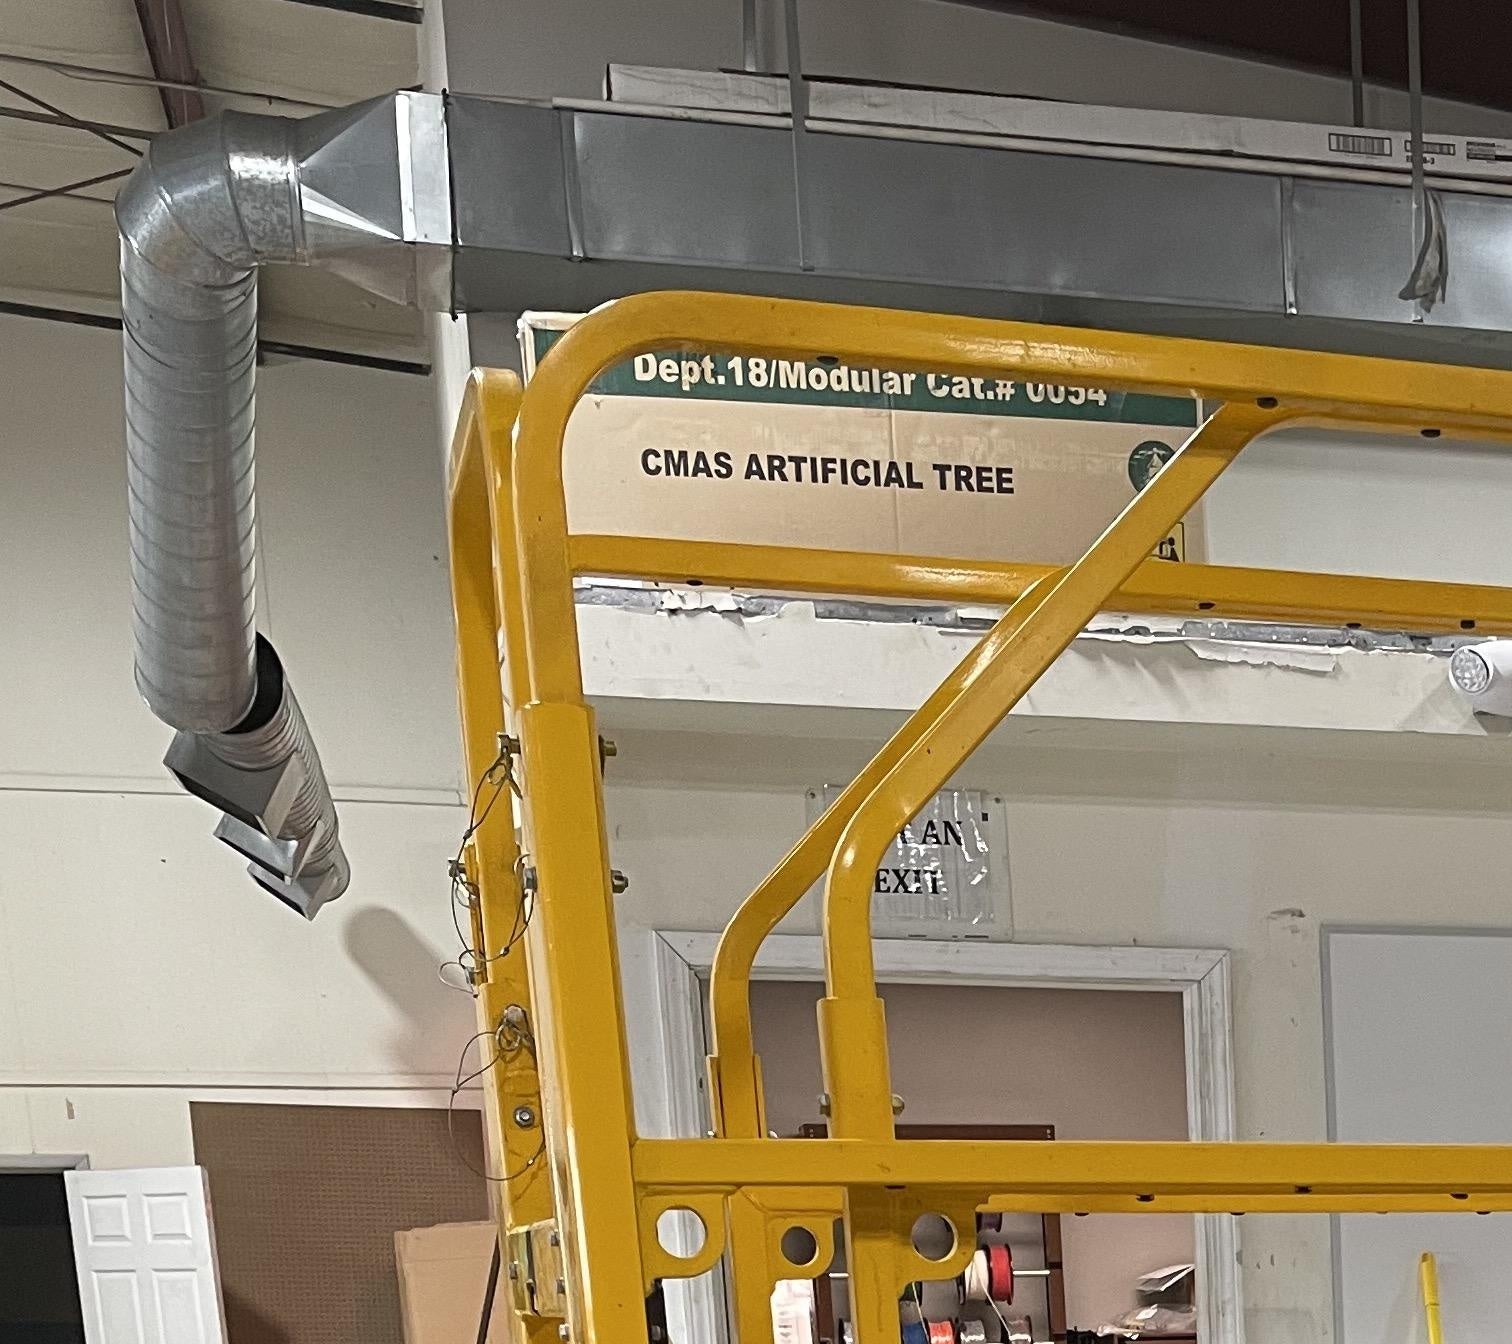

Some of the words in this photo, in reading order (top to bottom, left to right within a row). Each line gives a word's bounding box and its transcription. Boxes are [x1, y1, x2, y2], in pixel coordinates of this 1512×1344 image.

[633, 353, 915, 396] Dept.18/Modular
[641, 448, 733, 479] CMAS
[744, 454, 924, 490] ARTIFICIAL
[933, 464, 1015, 494] TREE
[874, 868, 941, 895] EXIT
